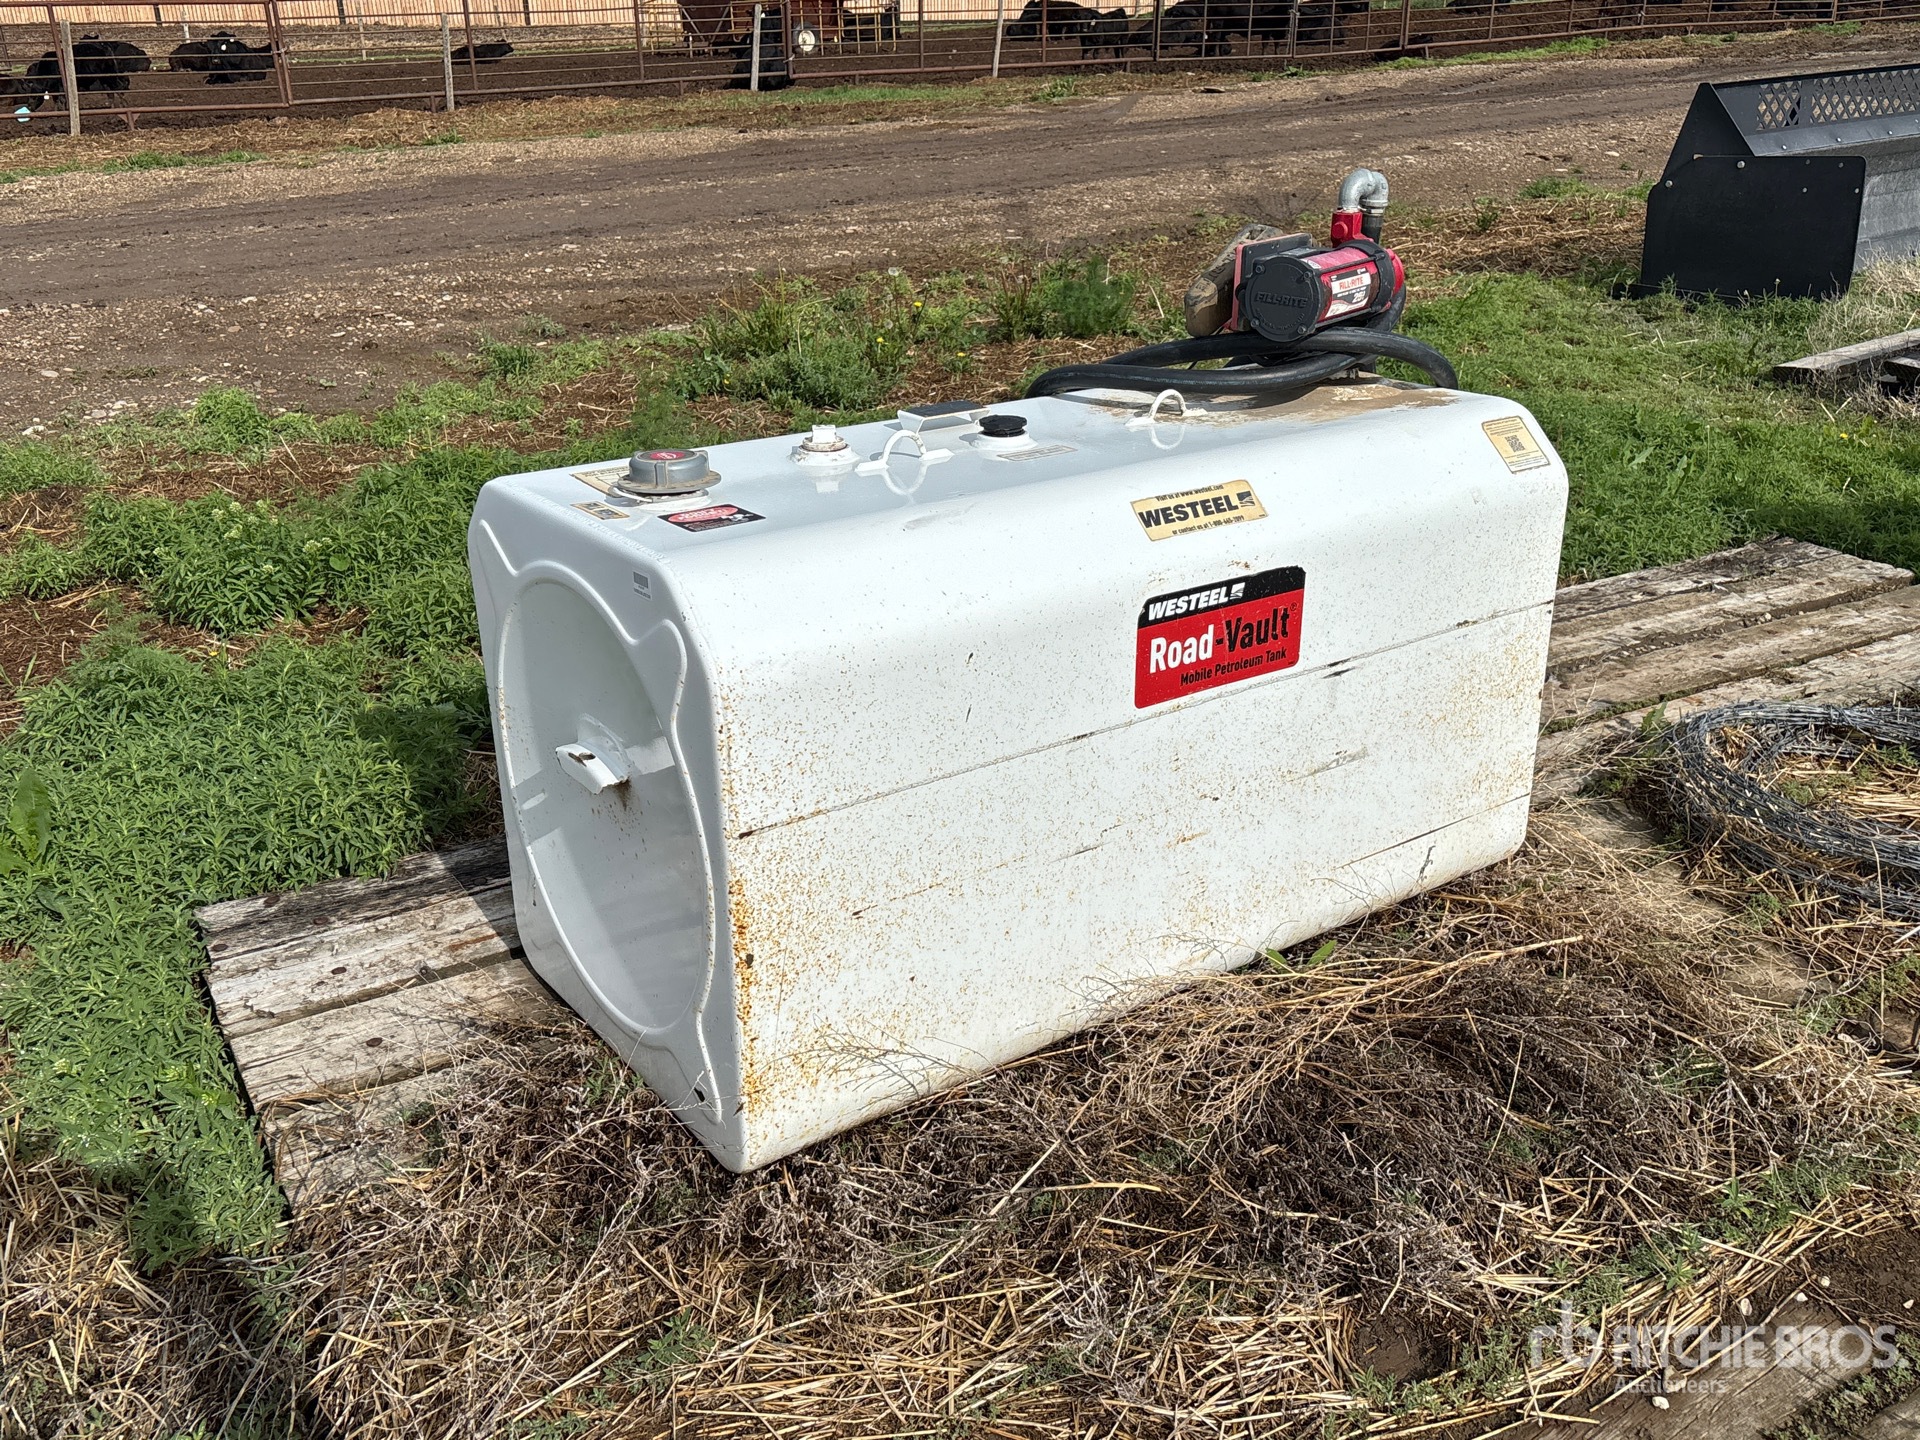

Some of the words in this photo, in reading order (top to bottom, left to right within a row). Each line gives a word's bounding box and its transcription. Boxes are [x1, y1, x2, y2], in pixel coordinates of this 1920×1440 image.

[1138, 494, 1239, 528] WESTEEL
[1179, 525, 1197, 534] contact
[1148, 586, 1229, 621] WESTEEL
[1180, 667, 1212, 686] Mobile
[1215, 655, 1263, 677] Petroleum
[1266, 647, 1287, 665] Tank
